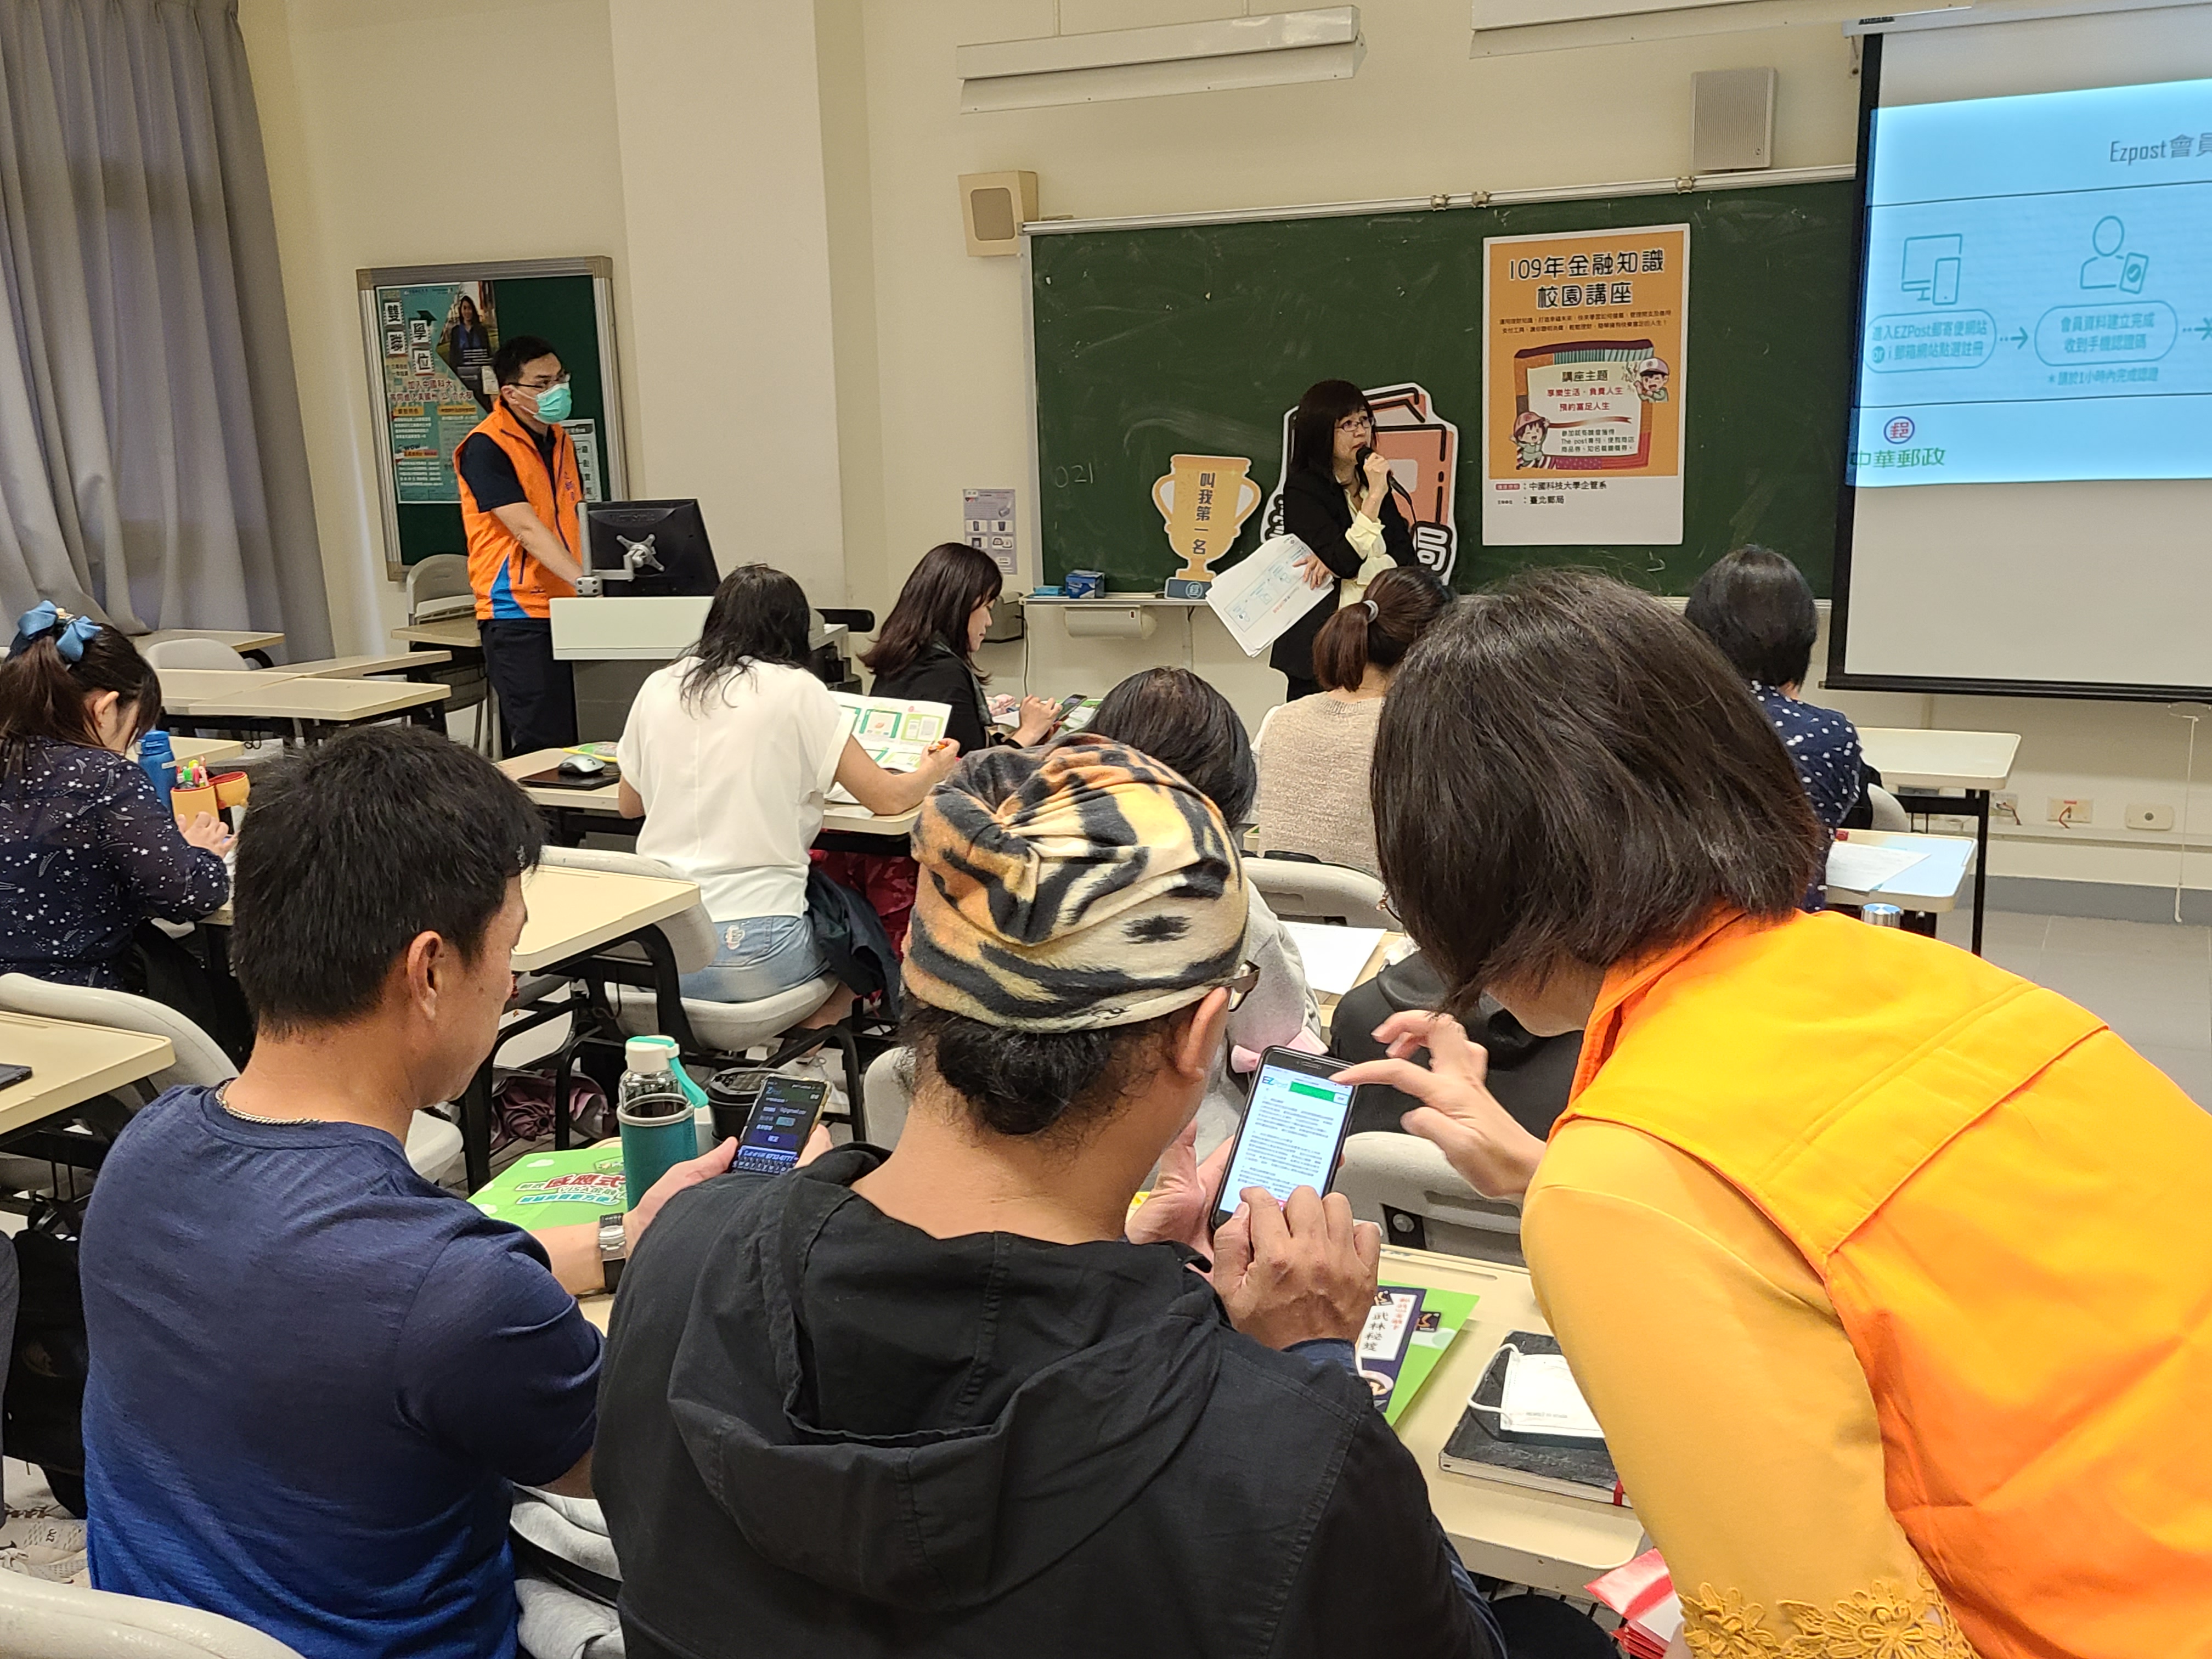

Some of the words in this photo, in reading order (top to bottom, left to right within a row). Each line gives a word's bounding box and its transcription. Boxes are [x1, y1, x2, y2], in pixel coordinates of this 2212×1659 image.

[1510, 250, 1664, 280] 109年金融知識
[1537, 281, 1632, 308] 校園講座
[1562, 370, 1608, 382] 講座主題
[1849, 448, 1946, 469] 中華郵政
[1192, 472, 1216, 555] 叫我第一名
